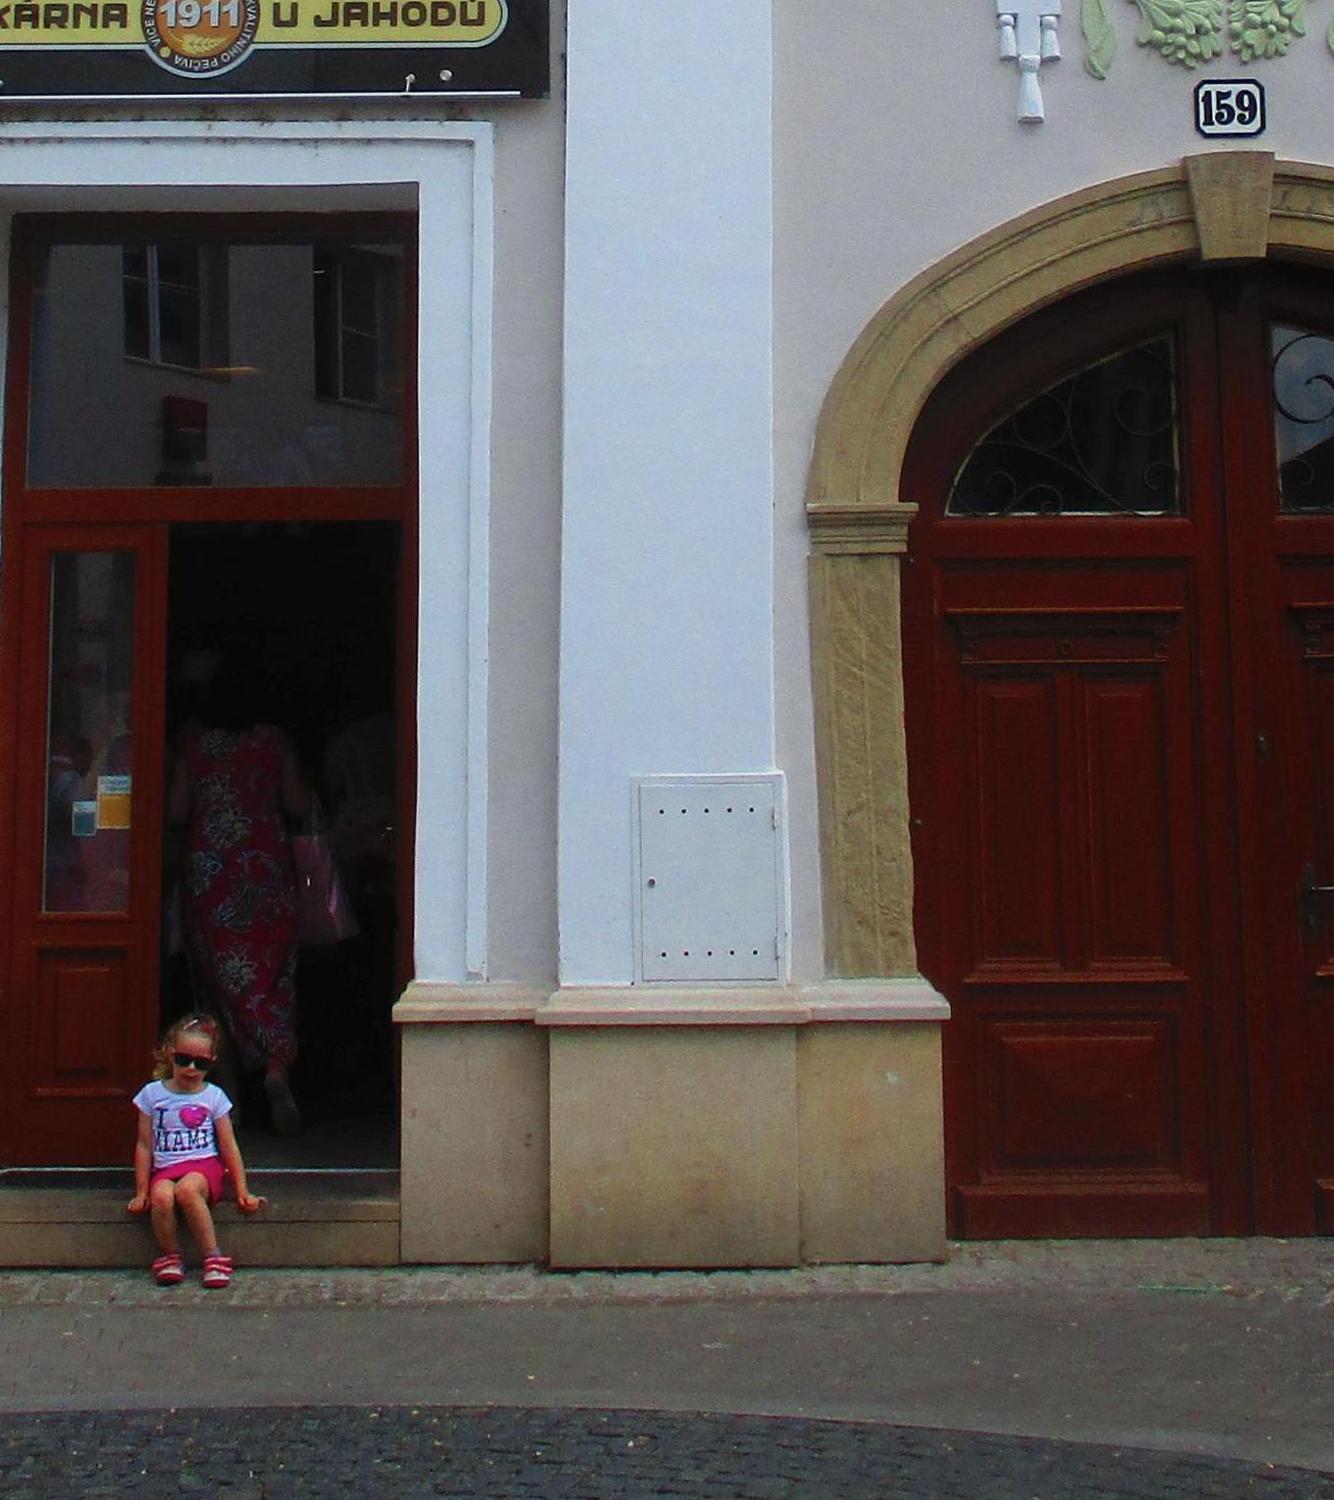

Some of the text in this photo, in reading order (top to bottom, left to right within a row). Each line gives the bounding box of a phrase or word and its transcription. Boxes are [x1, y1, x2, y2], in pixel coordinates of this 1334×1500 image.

[158, 0, 239, 28] 1911
[271, 2, 299, 28] U
[1201, 90, 1257, 126] 159
[154, 1106, 169, 1128] I
[155, 1128, 209, 1152] MIAMI
